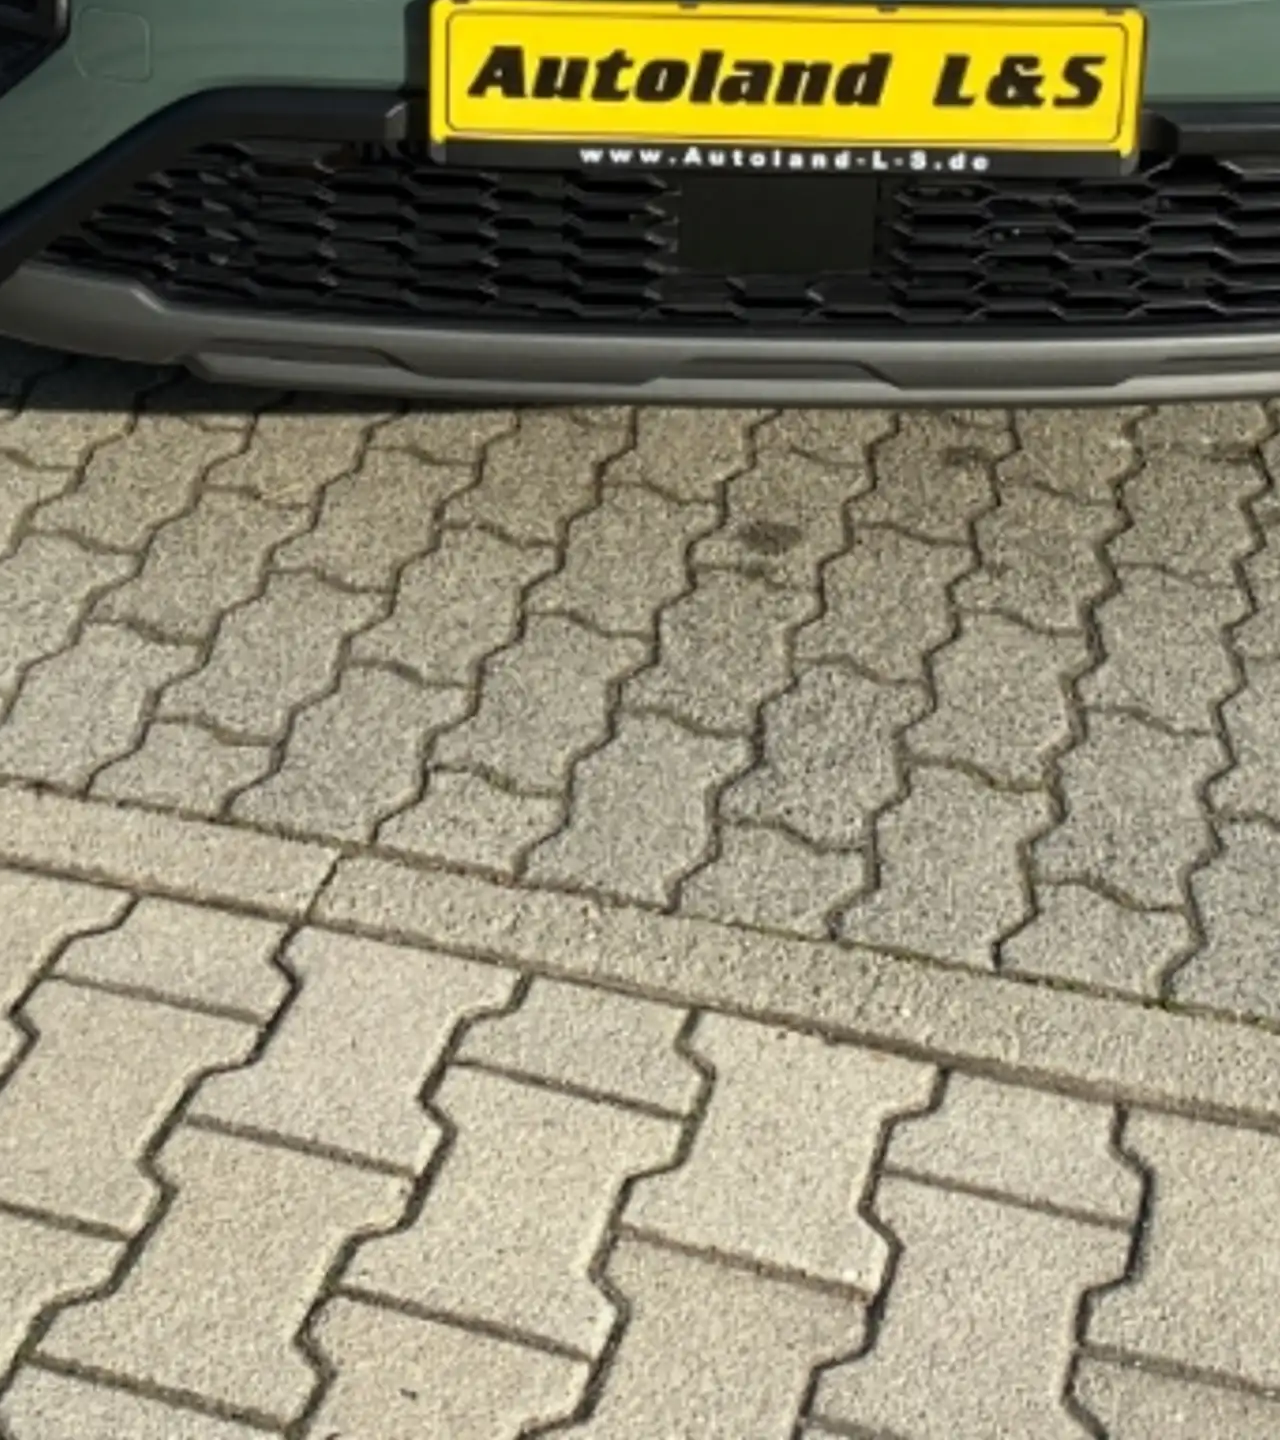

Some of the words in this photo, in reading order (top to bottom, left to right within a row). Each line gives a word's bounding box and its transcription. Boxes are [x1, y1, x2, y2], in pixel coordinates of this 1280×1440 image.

[467, 44, 892, 107] Autoland
[933, 54, 1106, 108] L&S
[579, 145, 990, 172] www.Autoland-L-S.de
